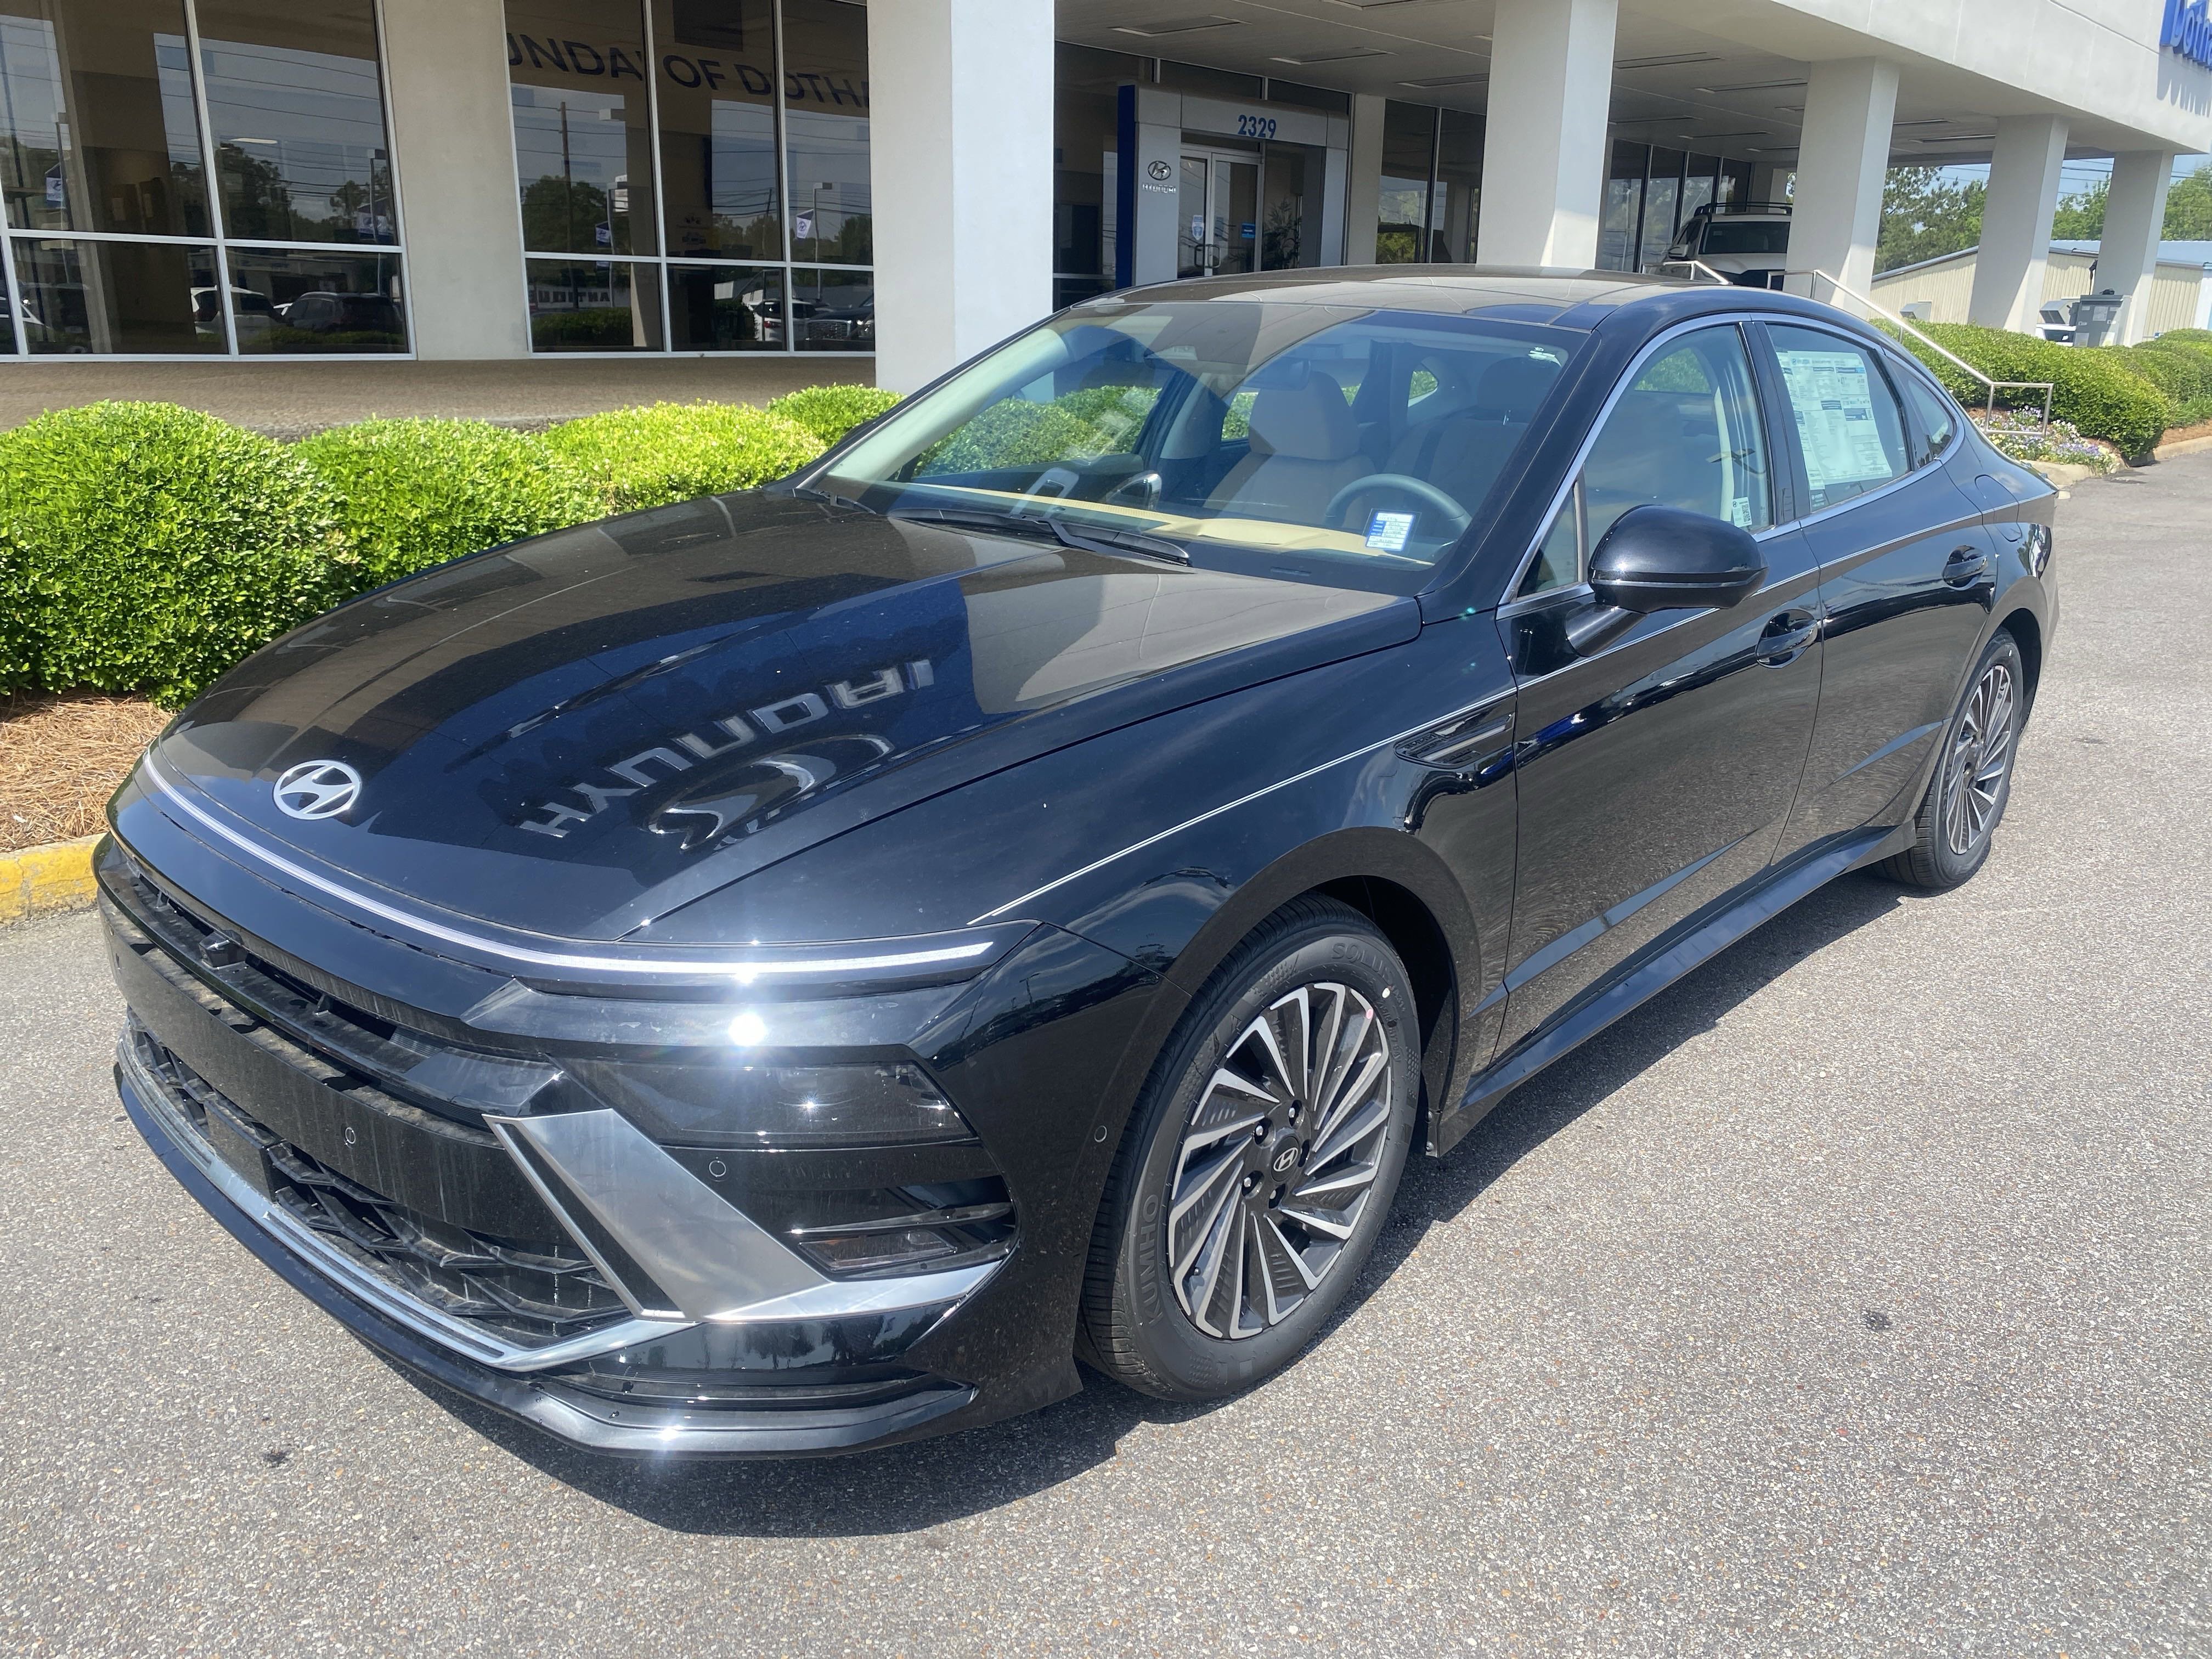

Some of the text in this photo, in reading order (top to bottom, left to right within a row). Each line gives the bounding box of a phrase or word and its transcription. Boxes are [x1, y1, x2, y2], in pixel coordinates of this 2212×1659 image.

[663, 55, 725, 91] OF
[733, 63, 868, 108] DOTH
[1238, 114, 1277, 139] 2329
[1142, 184, 1176, 194] HYUNDAI
[1139, 1194, 1163, 1325] KUMHO
